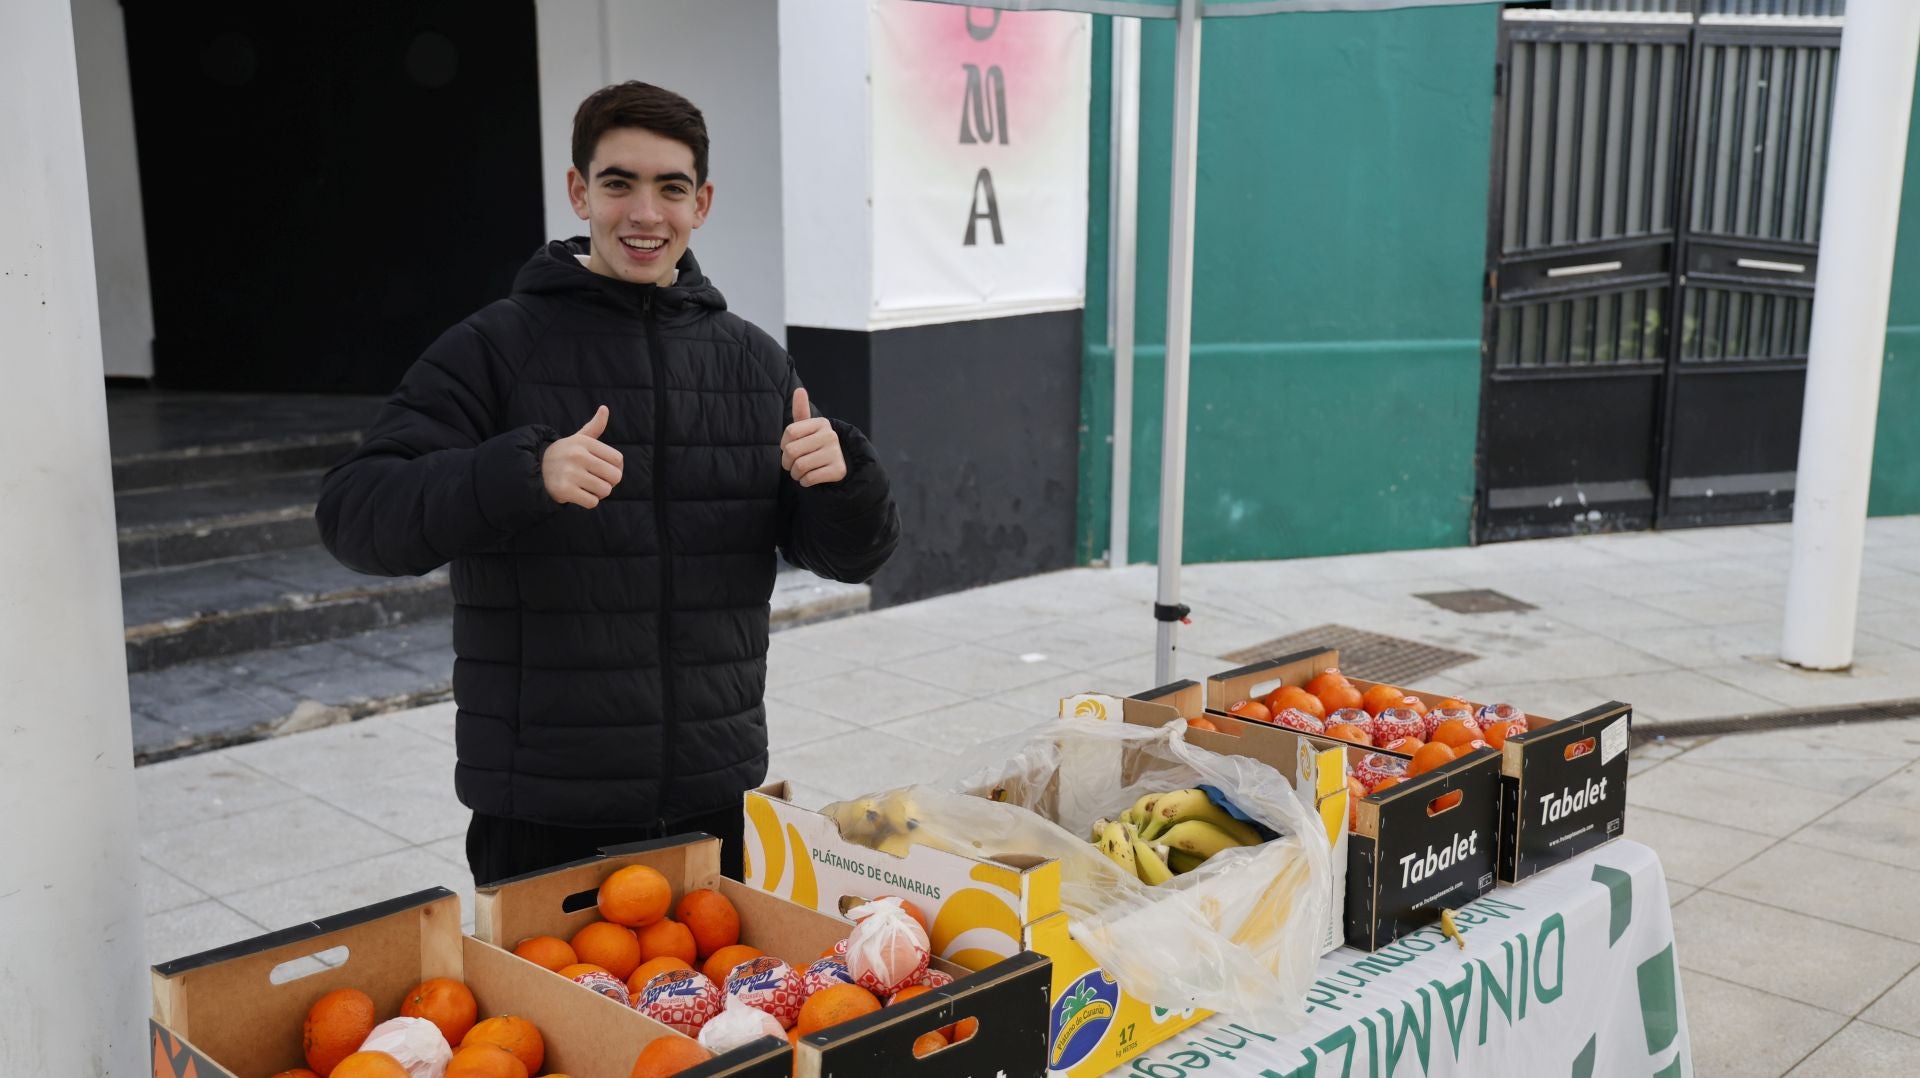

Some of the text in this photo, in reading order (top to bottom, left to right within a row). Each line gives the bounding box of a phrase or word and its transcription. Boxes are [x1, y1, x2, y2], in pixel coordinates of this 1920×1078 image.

[1539, 775, 1608, 826] Tabalet
[812, 848, 941, 900] PLÁTANOS DE CANARIAS
[1399, 829, 1478, 889] Tabalet
[1119, 1023, 1135, 1046] 17
[1129, 1023, 1278, 1078] Integ
